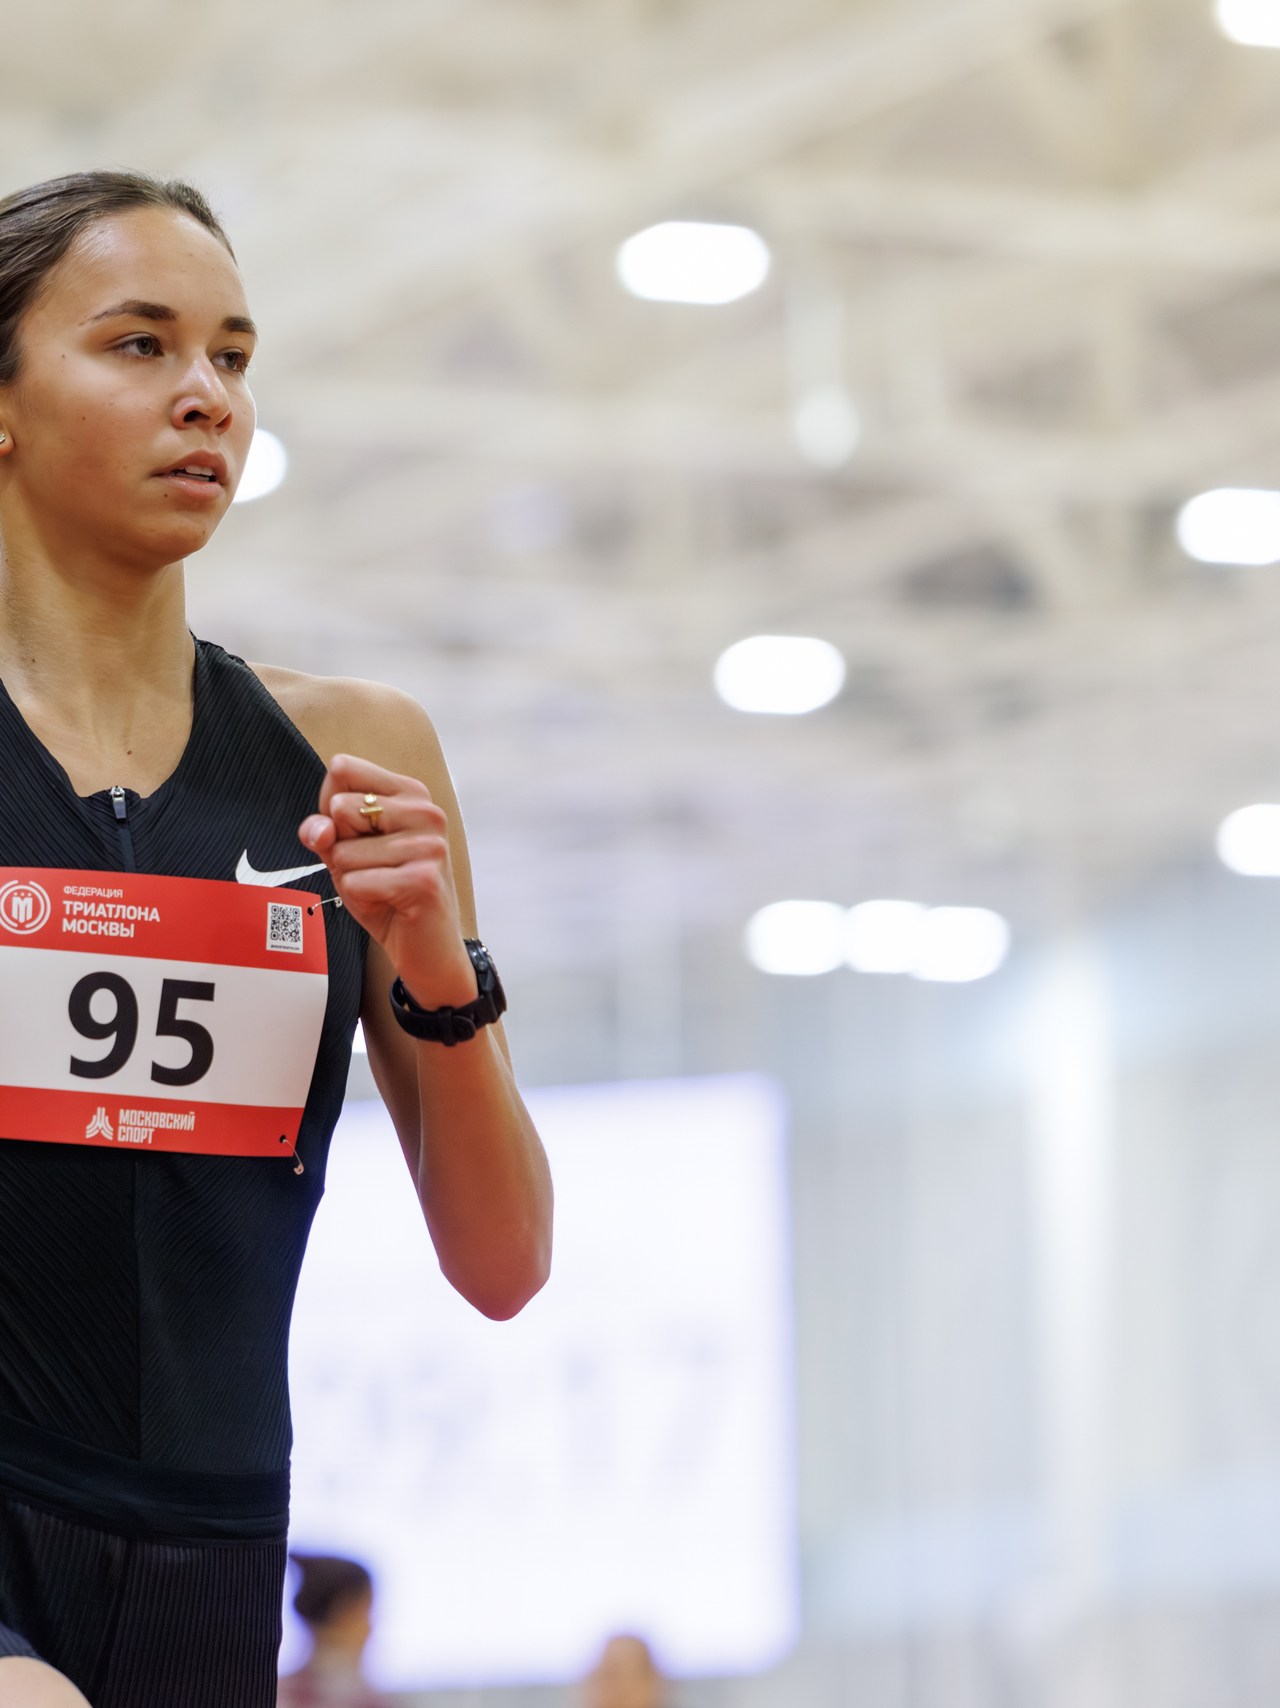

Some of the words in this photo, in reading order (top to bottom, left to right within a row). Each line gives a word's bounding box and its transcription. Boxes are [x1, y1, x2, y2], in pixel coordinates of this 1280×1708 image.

[63, 885, 124, 898] ФЕДЕРАЦИЯ
[62, 901, 161, 922] ТРИАТЛОНА
[62, 918, 135, 938] МОСКВЫ
[67, 971, 216, 1086] 95
[118, 1109, 196, 1131] МОСКОВСКИЙ
[117, 1125, 156, 1144] СПОРТ
